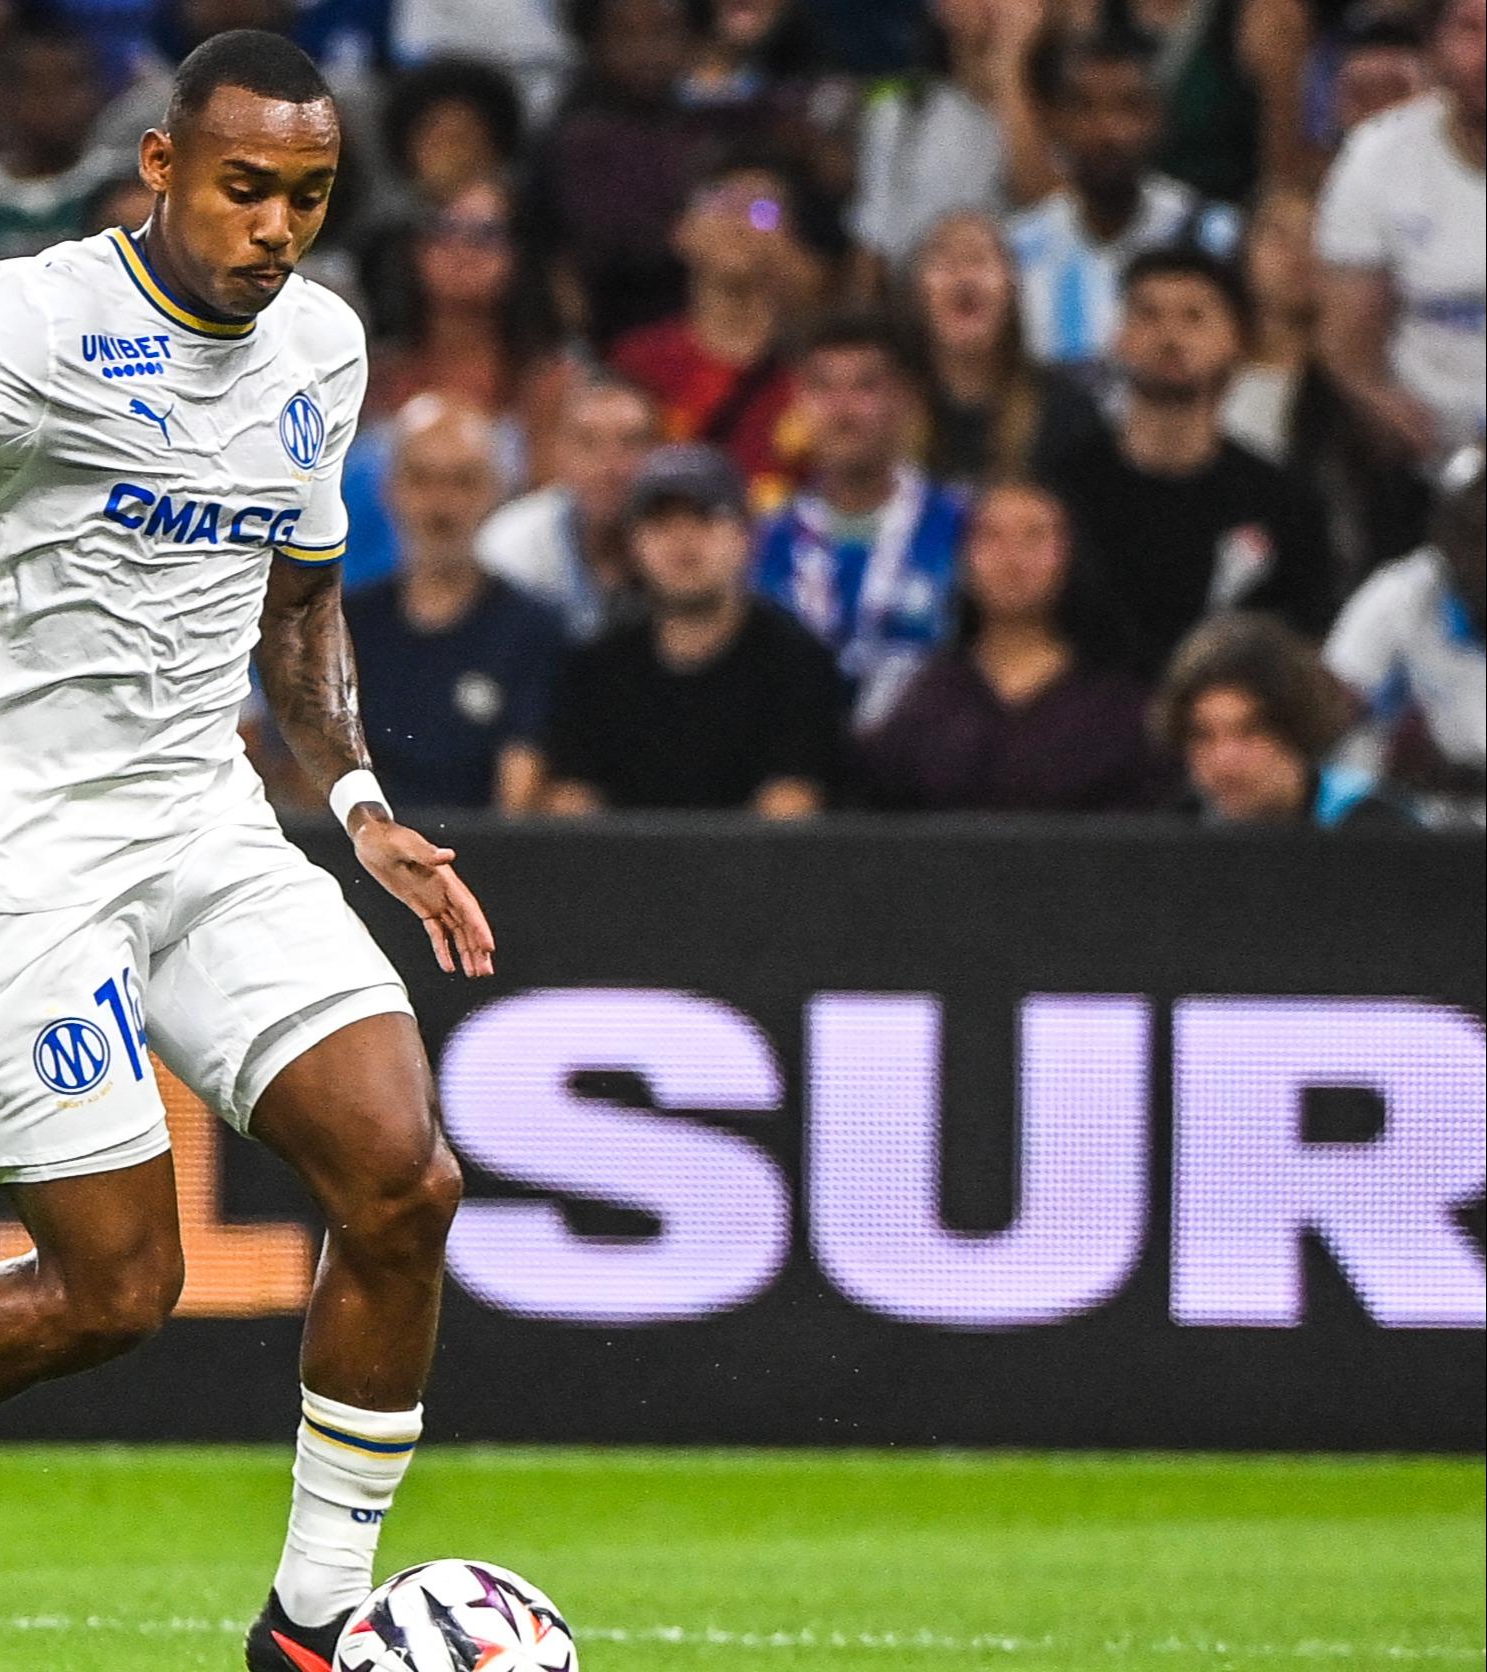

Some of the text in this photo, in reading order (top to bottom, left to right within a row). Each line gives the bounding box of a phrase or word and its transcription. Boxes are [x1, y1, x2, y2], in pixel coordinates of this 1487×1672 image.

[82, 335, 171, 362] UNIBET
[103, 482, 222, 544] CMA
[439, 988, 1486, 1328] SUR
